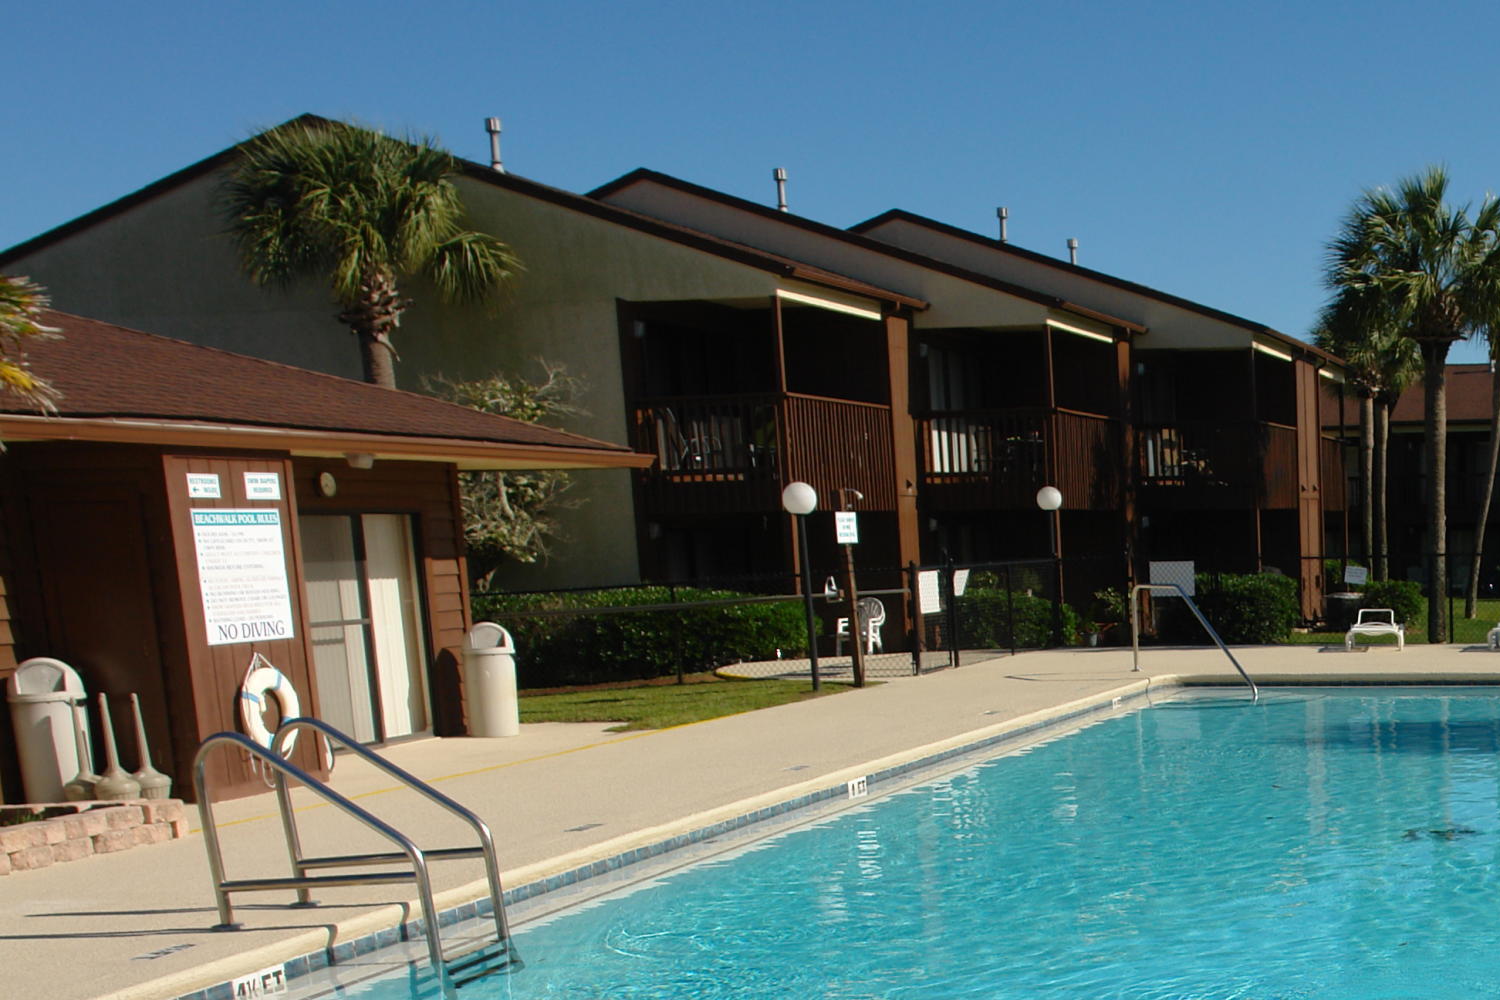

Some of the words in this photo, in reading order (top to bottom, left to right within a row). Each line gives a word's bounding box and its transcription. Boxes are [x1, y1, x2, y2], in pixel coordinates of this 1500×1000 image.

[237, 513, 257, 524] POOL
[218, 623, 238, 640] NO
[241, 619, 285, 639] DIVING
